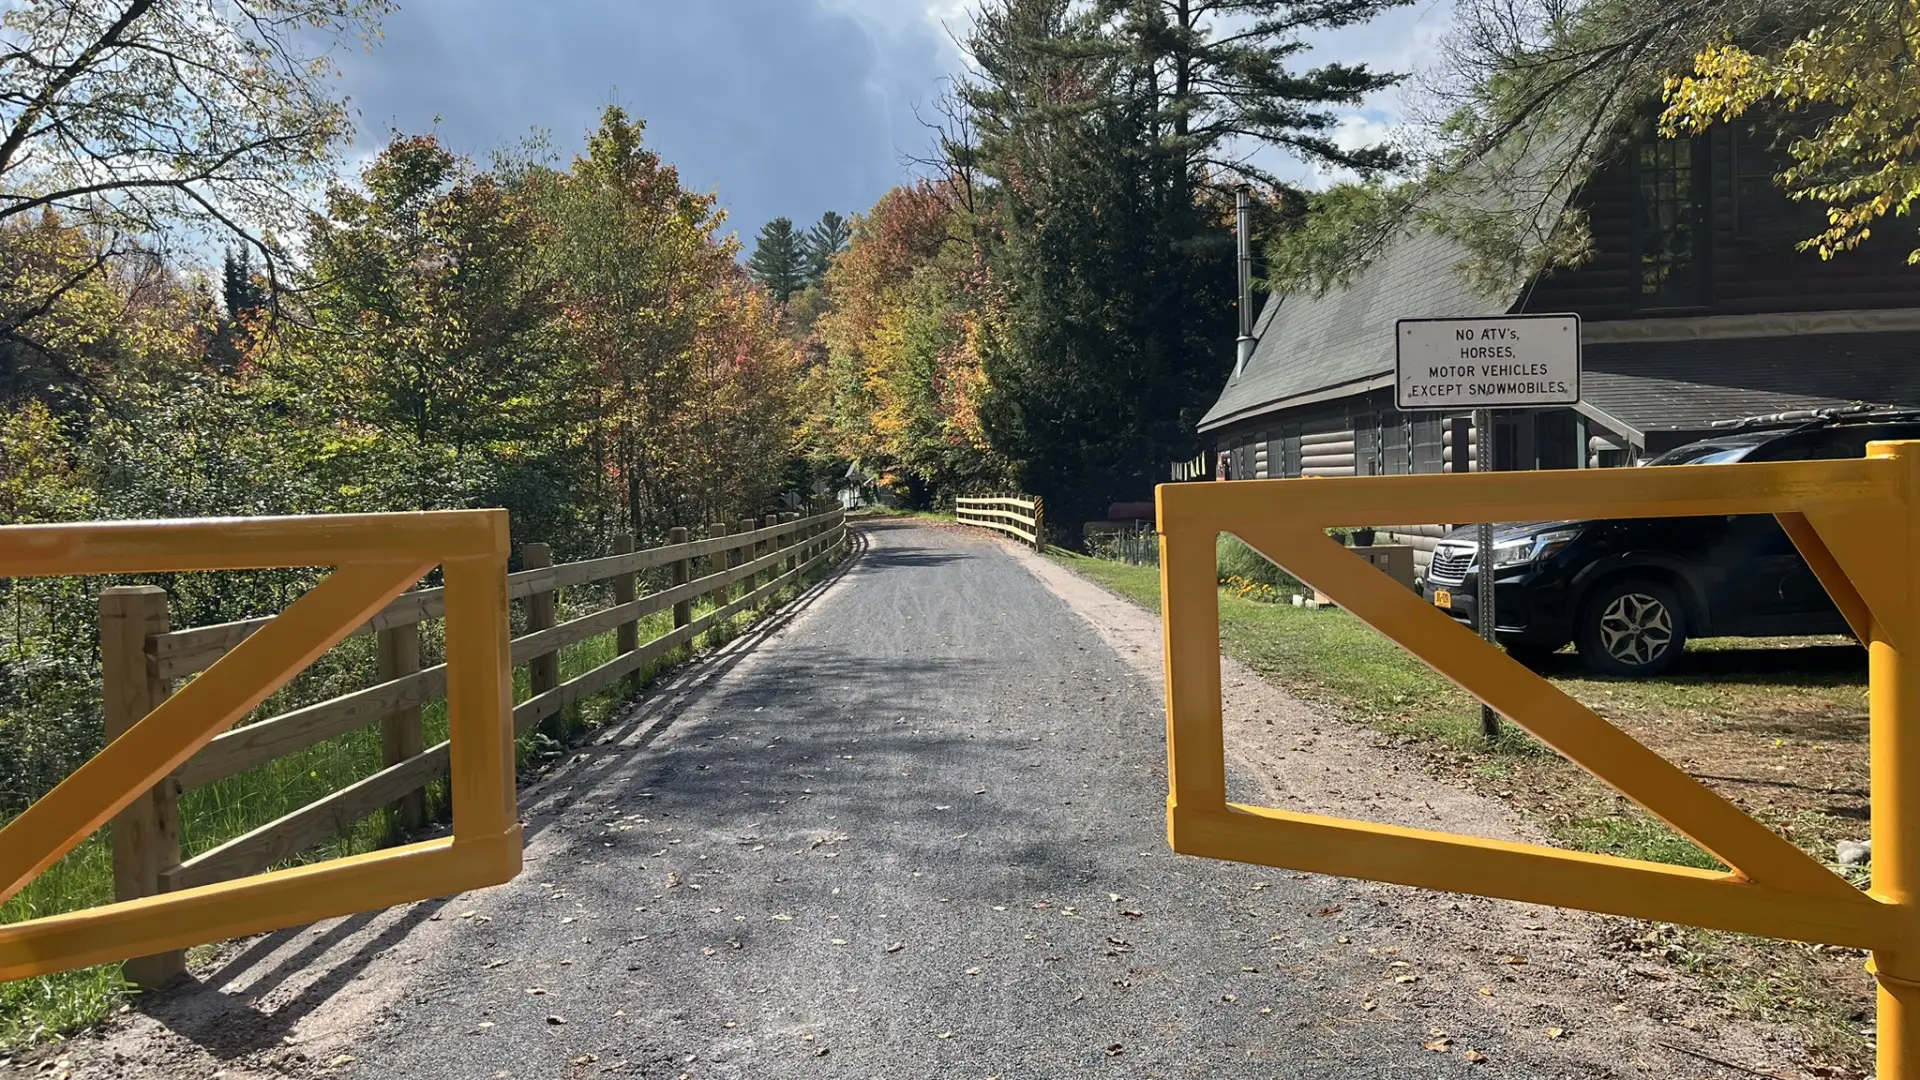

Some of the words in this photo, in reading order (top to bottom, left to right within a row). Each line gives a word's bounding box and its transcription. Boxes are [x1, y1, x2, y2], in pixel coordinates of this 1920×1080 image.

[1456, 329, 1474, 341] NO
[1481, 328, 1520, 341] ATV's,
[1461, 346, 1516, 359] HORSES,
[1429, 366, 1475, 378] MOTOR
[1481, 364, 1548, 376] VEHICLES
[1412, 384, 1462, 397] EXCEPT
[1469, 382, 1565, 396] SNOWMOBILES
